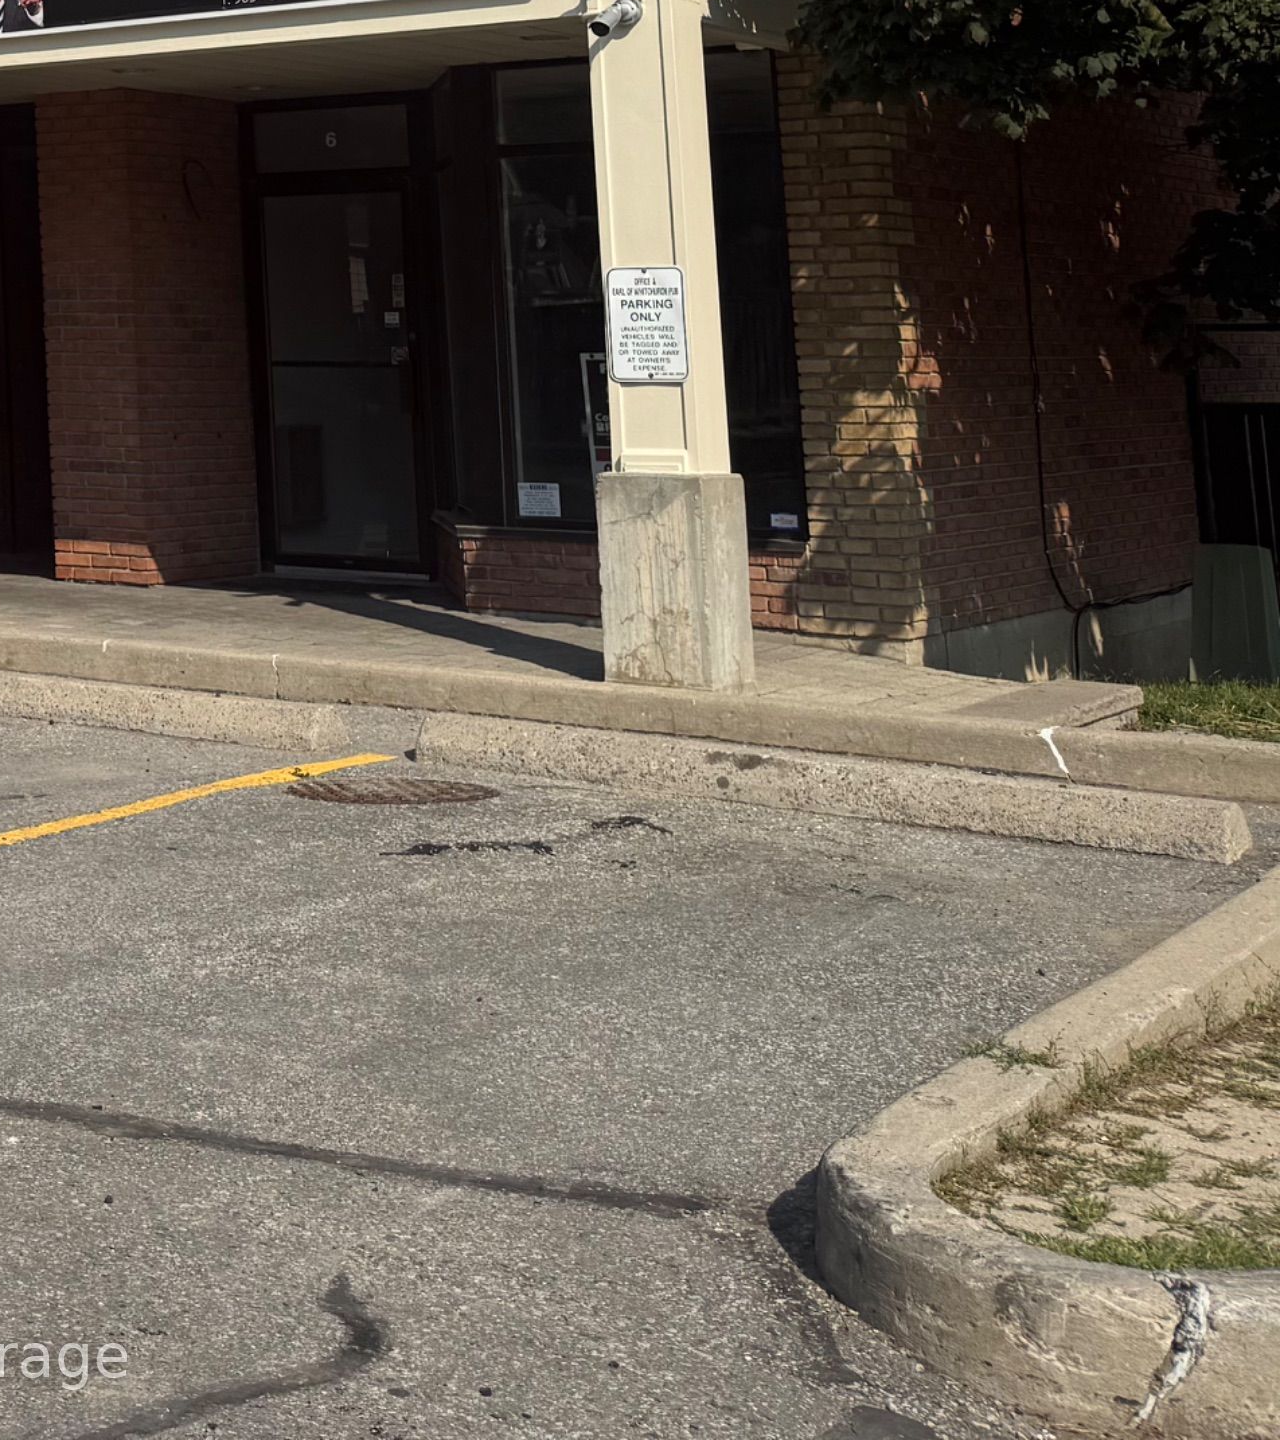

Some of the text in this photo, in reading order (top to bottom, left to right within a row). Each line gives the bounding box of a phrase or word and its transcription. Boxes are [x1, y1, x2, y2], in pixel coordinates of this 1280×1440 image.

[325, 131, 337, 148] 6
[620, 299, 673, 309] PARKING
[630, 312, 662, 322] ONLY
